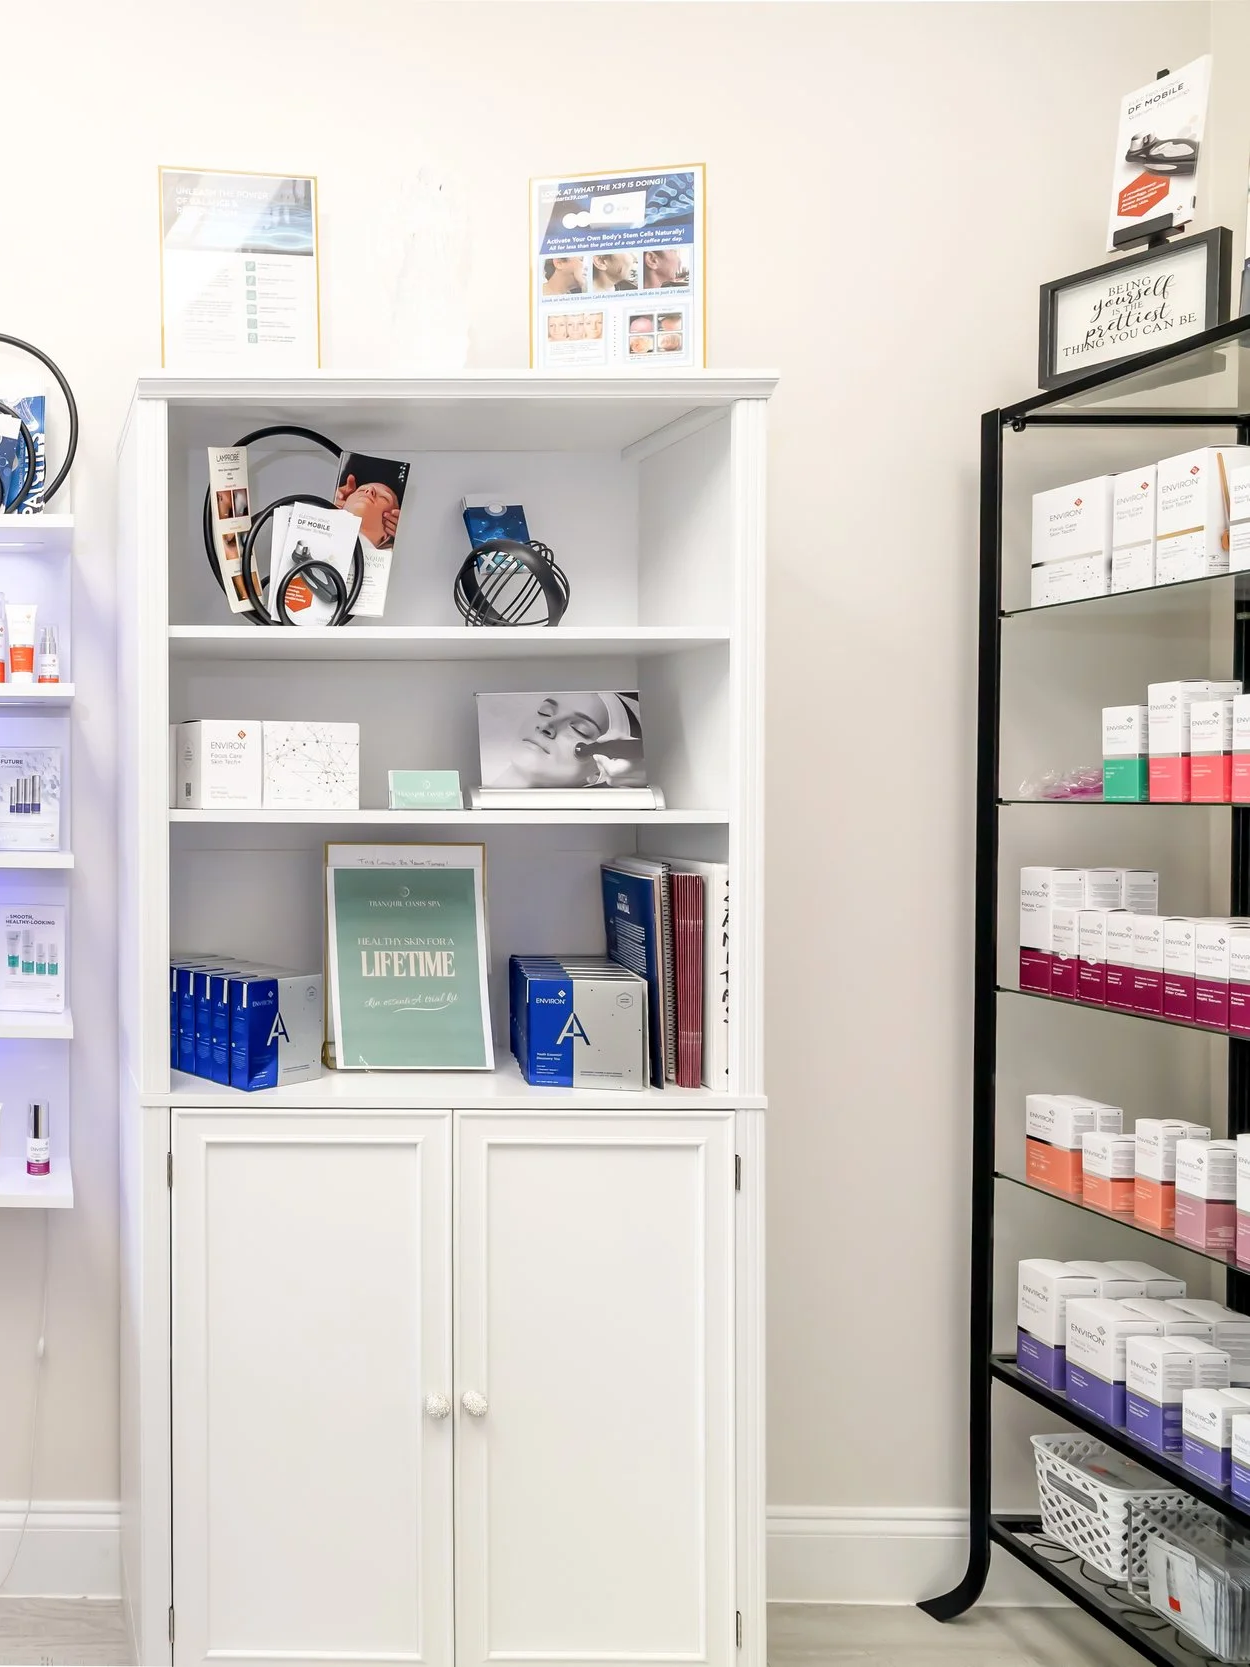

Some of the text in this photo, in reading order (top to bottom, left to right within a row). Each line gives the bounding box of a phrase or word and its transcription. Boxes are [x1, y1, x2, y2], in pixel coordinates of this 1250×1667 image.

[1128, 103, 1141, 114] DF
[1145, 83, 1184, 106] MOBILE
[574, 186, 595, 194] WHAT
[1108, 276, 1151, 296] BEING
[1090, 274, 1175, 323] yourself
[1124, 301, 1144, 312] THE
[1084, 302, 1172, 348] prettiest
[1063, 313, 1196, 356] THING YOU CAN BE
[1162, 477, 1200, 493] ENVIRON
[1117, 492, 1148, 505] ENVIRON
[1050, 509, 1082, 521] ENVIRON
[308, 522, 330, 531] MOBILE
[1135, 934, 1159, 942] ENVIRON
[1197, 944, 1225, 952] ENVIRON
[361, 951, 455, 977] LIFETIME
[267, 1012, 290, 1046] A
[556, 1012, 590, 1046] A
[1030, 1112, 1054, 1123] ENVIRON
[1137, 1136, 1158, 1146] ENVIRON
[1084, 1149, 1106, 1160] ENVIRON
[1177, 1159, 1202, 1171] ENVIRON
[1023, 1285, 1048, 1302] ENVIRON
[1071, 1324, 1106, 1346] ENVIRON
[1131, 1360, 1157, 1376] ENVIRON
[1185, 1408, 1216, 1427] ENVIRON
